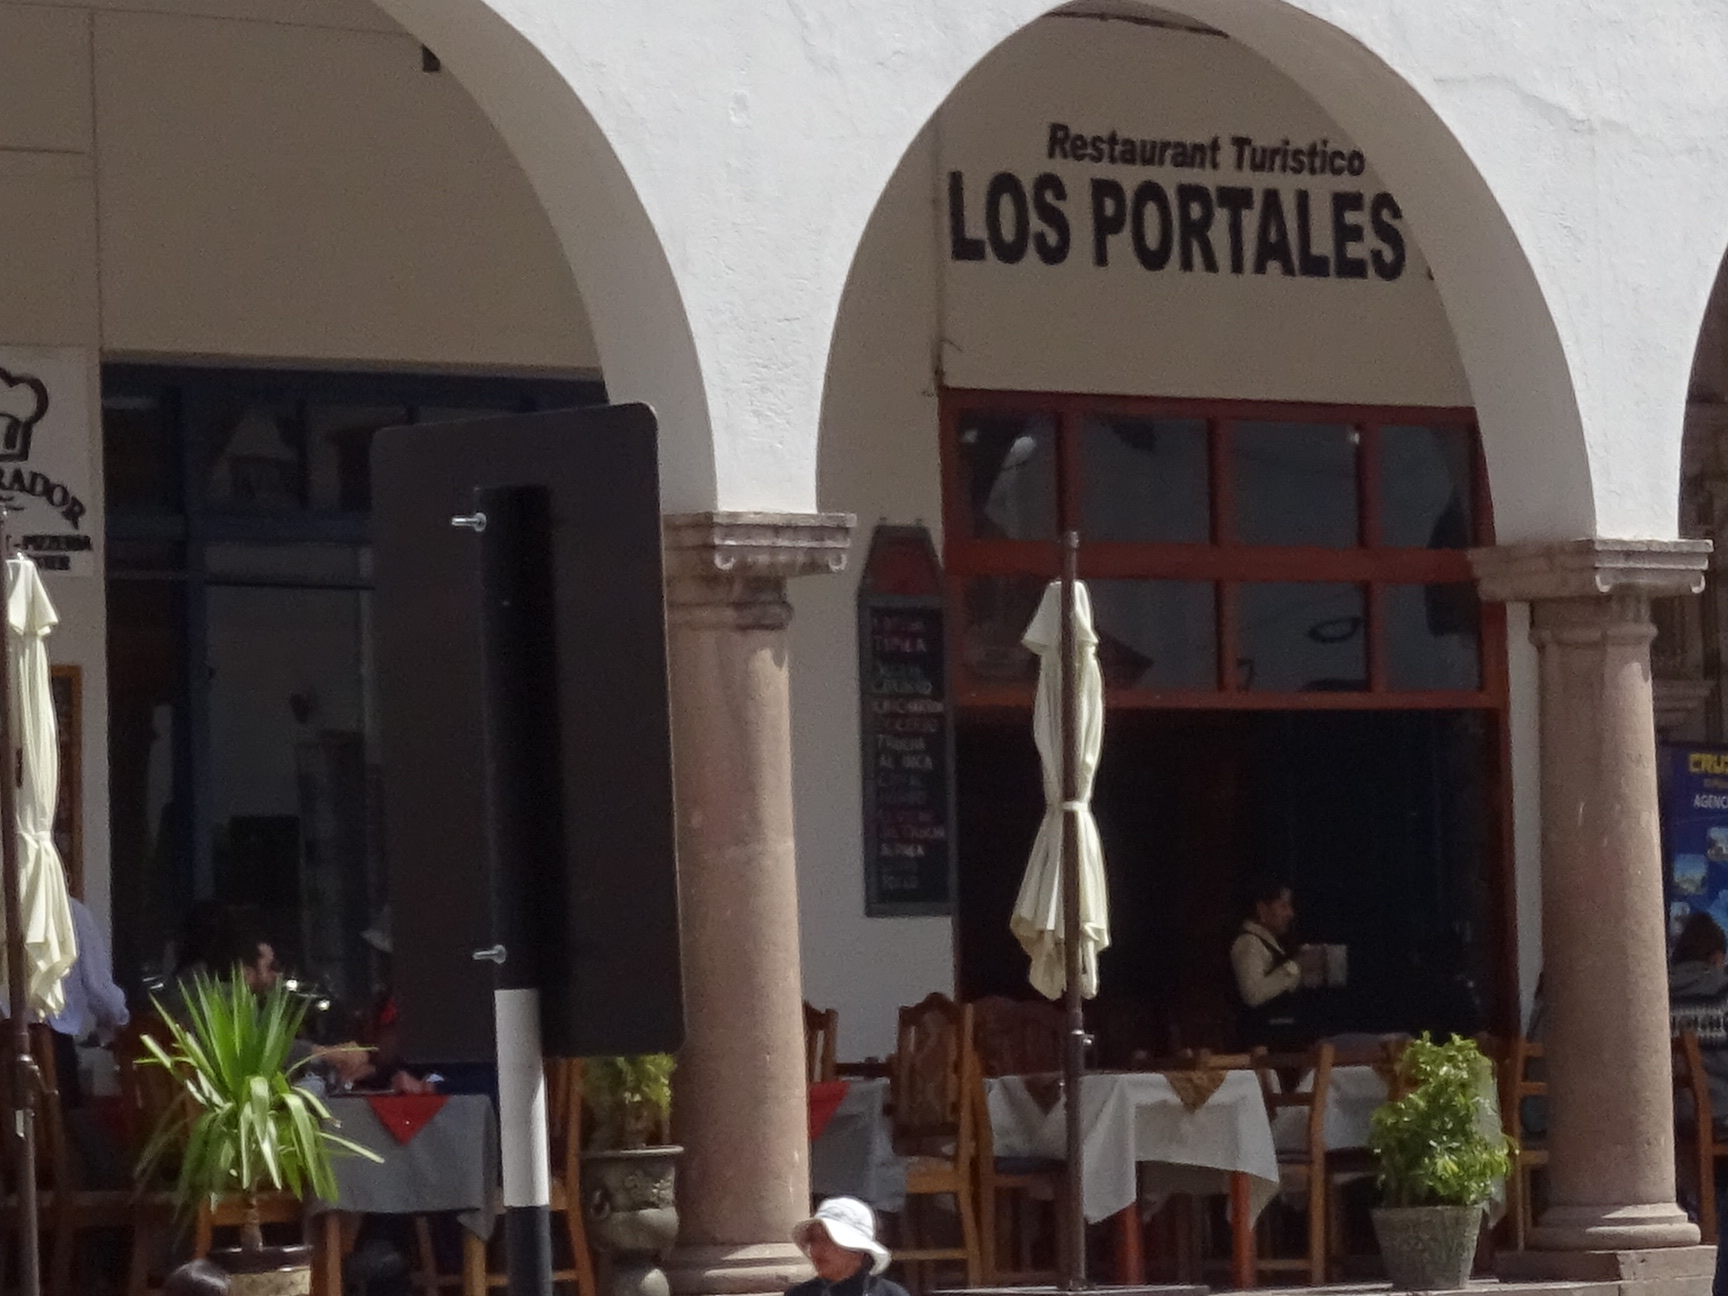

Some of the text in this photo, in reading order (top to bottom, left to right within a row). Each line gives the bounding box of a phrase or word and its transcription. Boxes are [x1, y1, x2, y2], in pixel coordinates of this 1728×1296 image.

[1048, 123, 1366, 177] Restaurant Turistico
[948, 170, 1406, 281] LOS PORTALES
